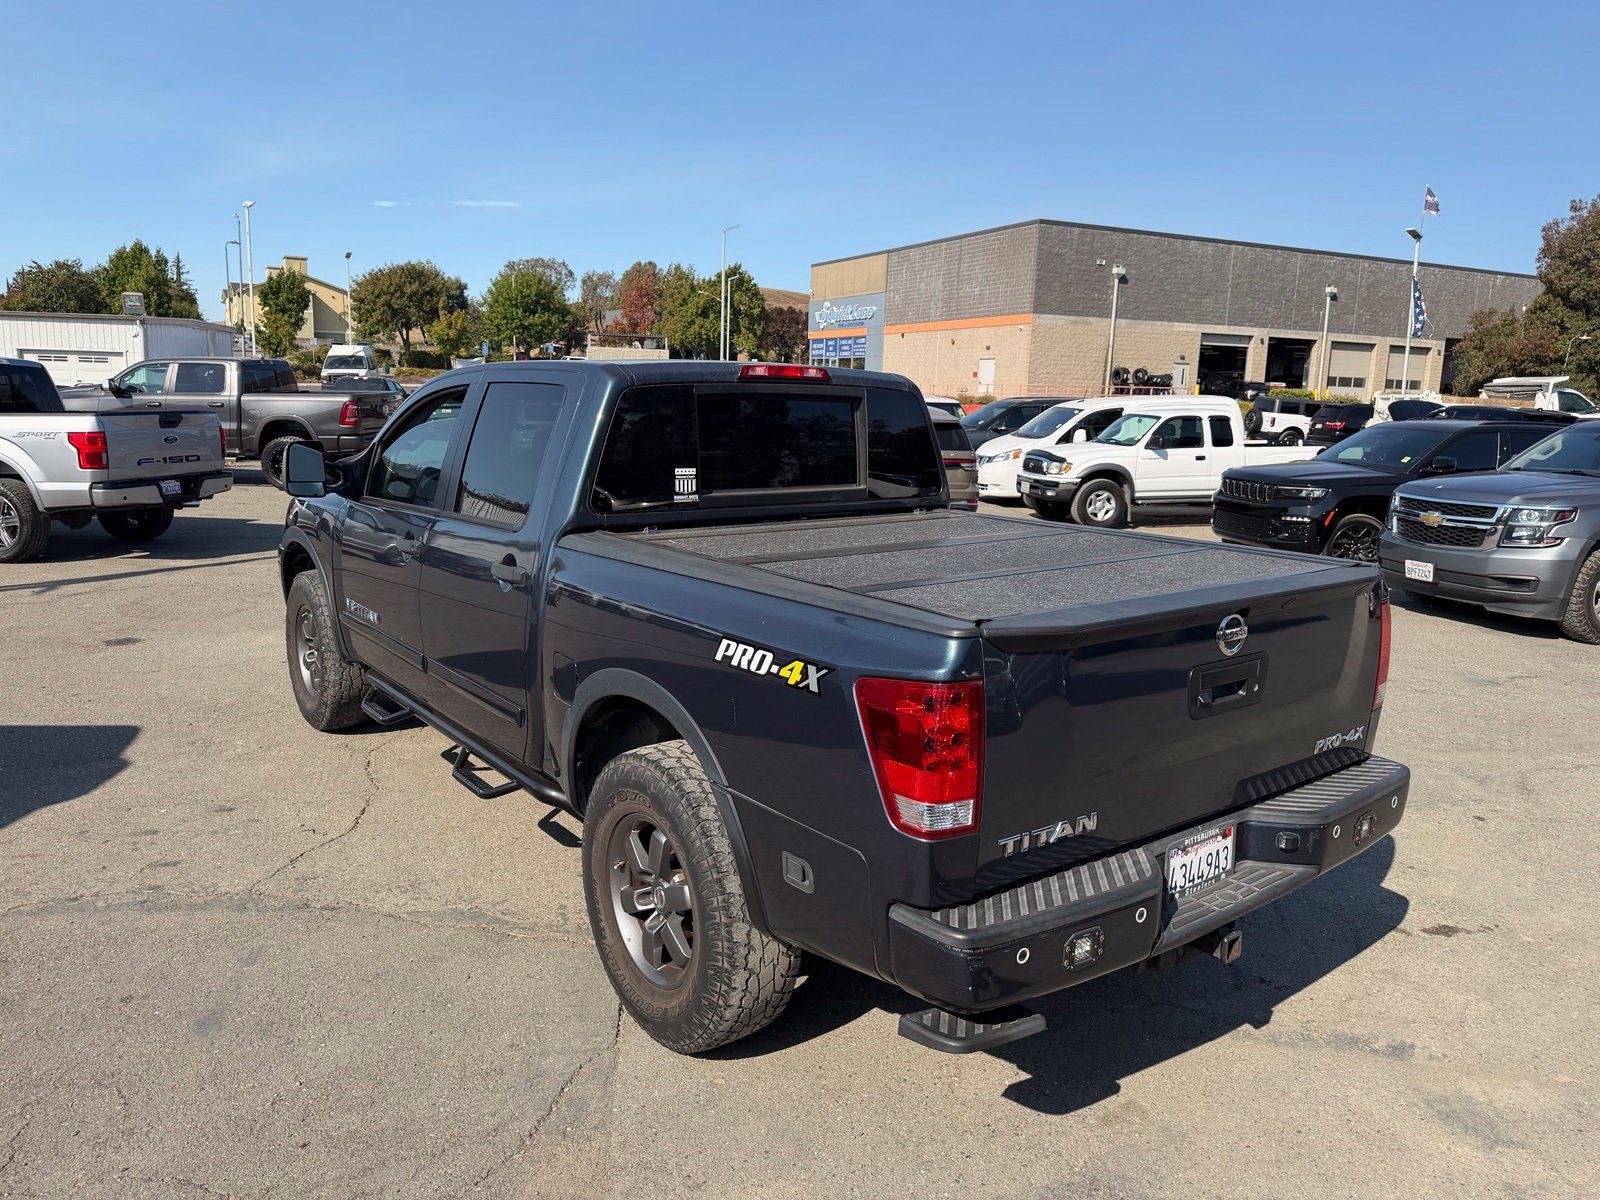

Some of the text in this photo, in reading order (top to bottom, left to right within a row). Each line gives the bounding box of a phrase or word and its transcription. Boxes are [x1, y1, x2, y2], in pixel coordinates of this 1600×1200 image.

[828, 304, 877, 324] Quick Lane
[137, 454, 201, 466] F-150
[714, 638, 829, 693] PRO-4X
[1313, 725, 1365, 755] PRO-4X
[607, 788, 652, 809] TOYO
[997, 811, 1098, 858] TITAN
[1185, 827, 1220, 847] PITTSBURGH
[1169, 845, 1230, 893] 43449A3
